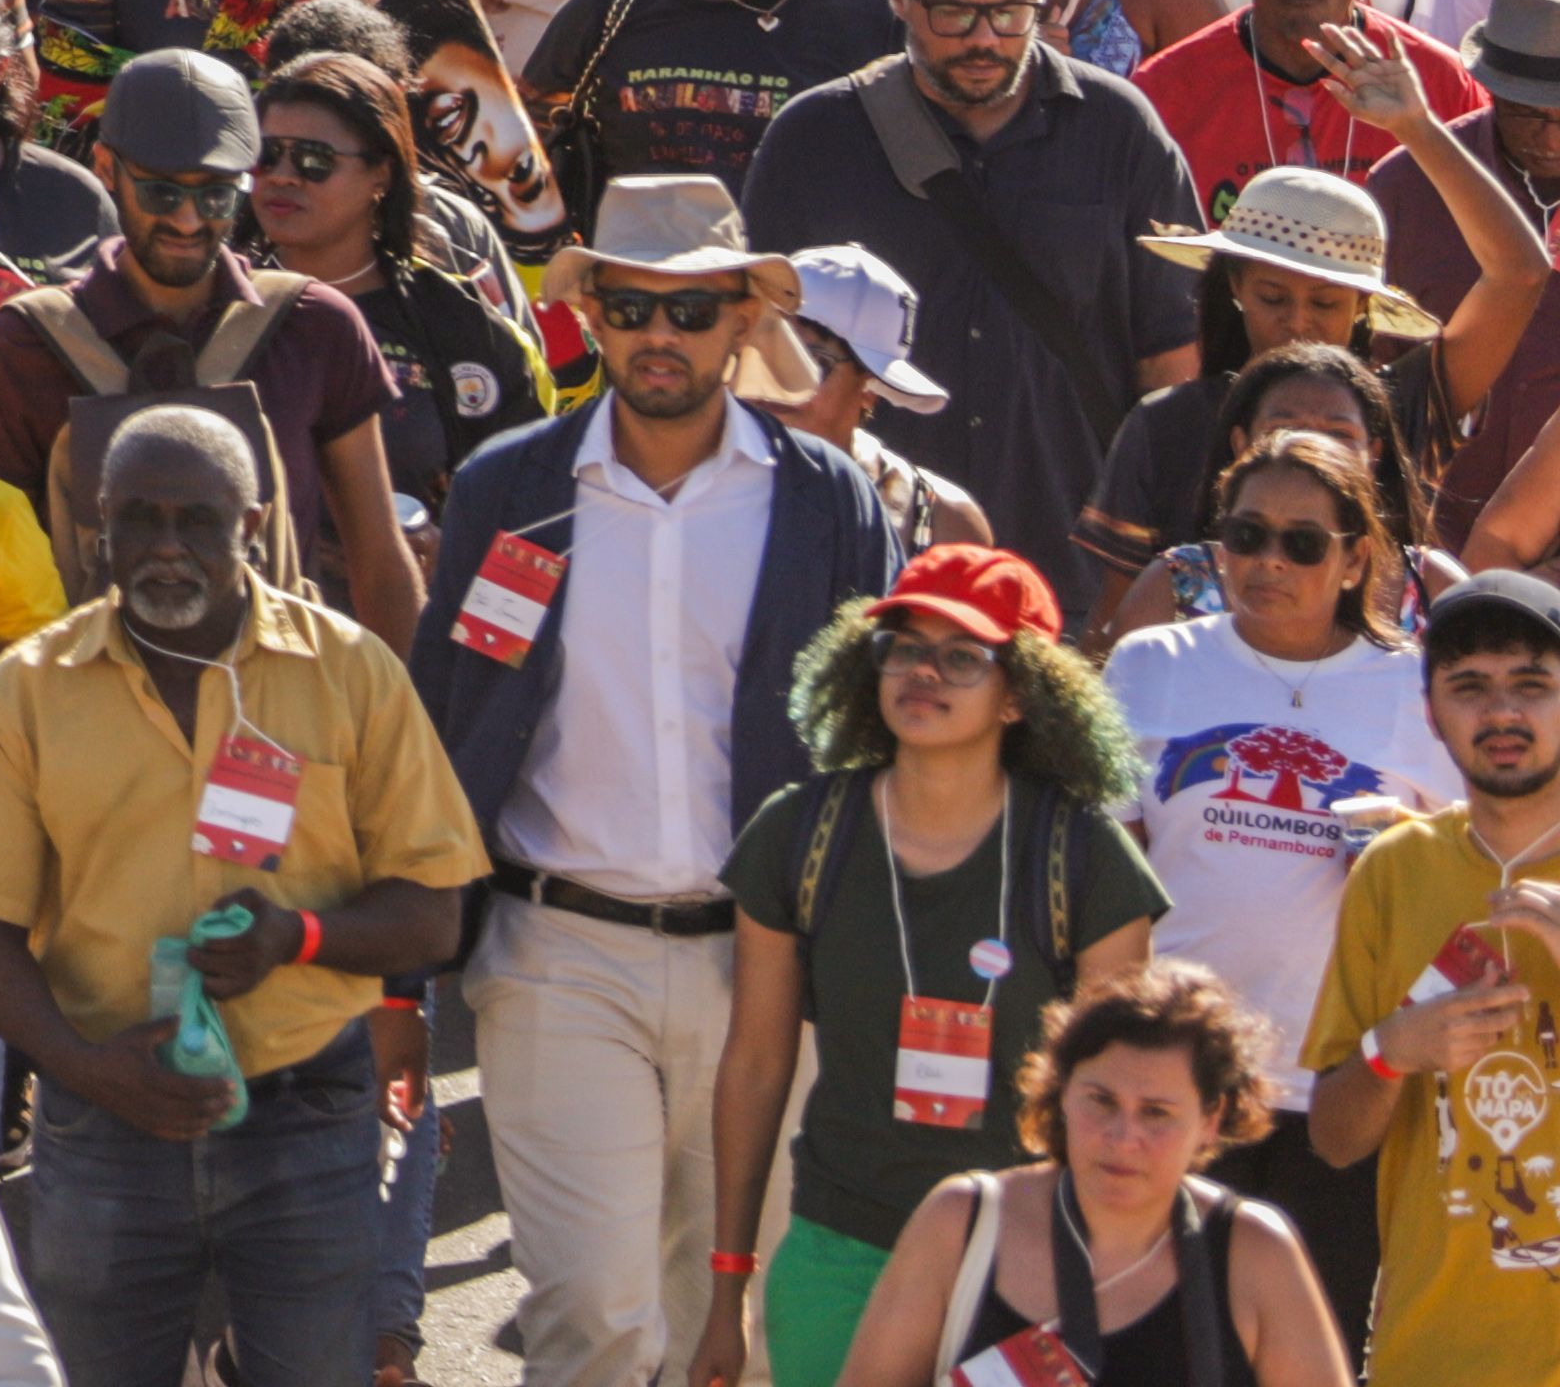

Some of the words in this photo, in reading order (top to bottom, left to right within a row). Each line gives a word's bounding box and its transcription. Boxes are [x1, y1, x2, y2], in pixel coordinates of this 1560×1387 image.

[1204, 827, 1224, 844] de
[1228, 830, 1337, 860] Pernambuco
[1475, 1097, 1538, 1120] MAPA
